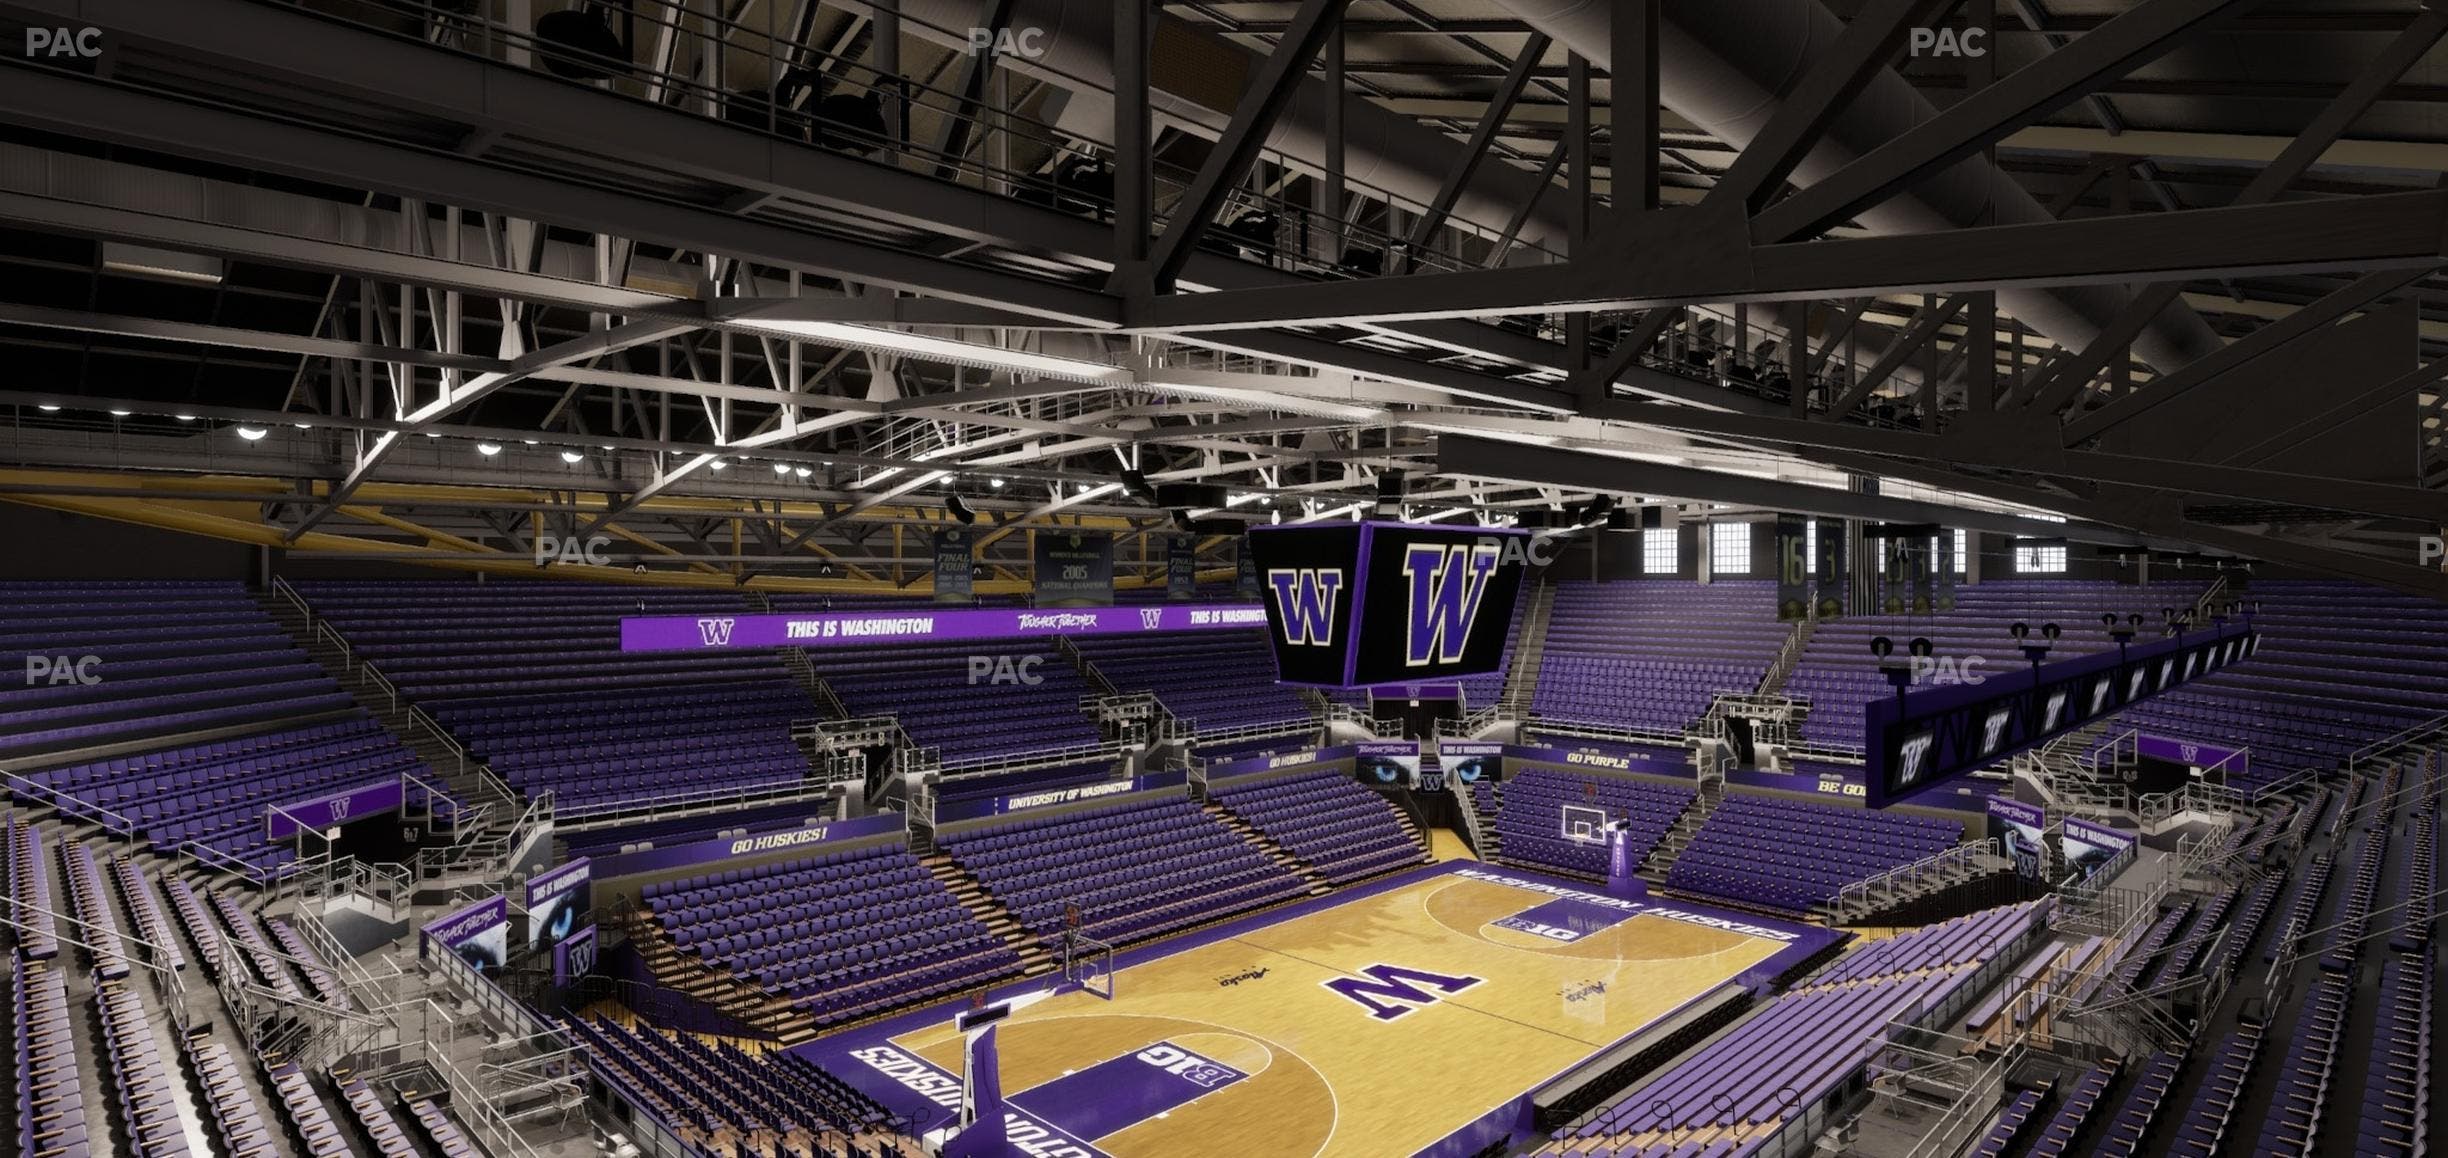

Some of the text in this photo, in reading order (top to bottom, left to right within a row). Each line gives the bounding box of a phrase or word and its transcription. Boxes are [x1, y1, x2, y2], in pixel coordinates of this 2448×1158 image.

[1063, 565, 1088, 579] 2005
[1268, 568, 1343, 646] W
[1402, 543, 1501, 667] W
[1018, 613, 1097, 630] TOUGHER TOGETHER
[1140, 608, 1162, 629] W
[1190, 609, 1268, 624] THIS IS WASHINGT
[698, 619, 734, 646] W
[787, 617, 934, 638] THIS IS WASHINGTON
[1269, 757, 1280, 768] GO
[1567, 753, 1630, 769] GO PURPLE
[2180, 744, 2198, 763] W
[1421, 773, 1443, 791] W
[1818, 781, 1840, 793] BE
[1008, 780, 1133, 810] UNIVERSITY OF WASHINGTON
[330, 797, 350, 821] W
[731, 826, 828, 854] GO HUSKIES!
[2066, 823, 2079, 836] THIS
[2080, 827, 2087, 839] IS
[533, 865, 590, 902] THIS IS WASHINGTON
[1453, 869, 1801, 940] WASHINGTON HUSKIES
[570, 939, 593, 977] W
